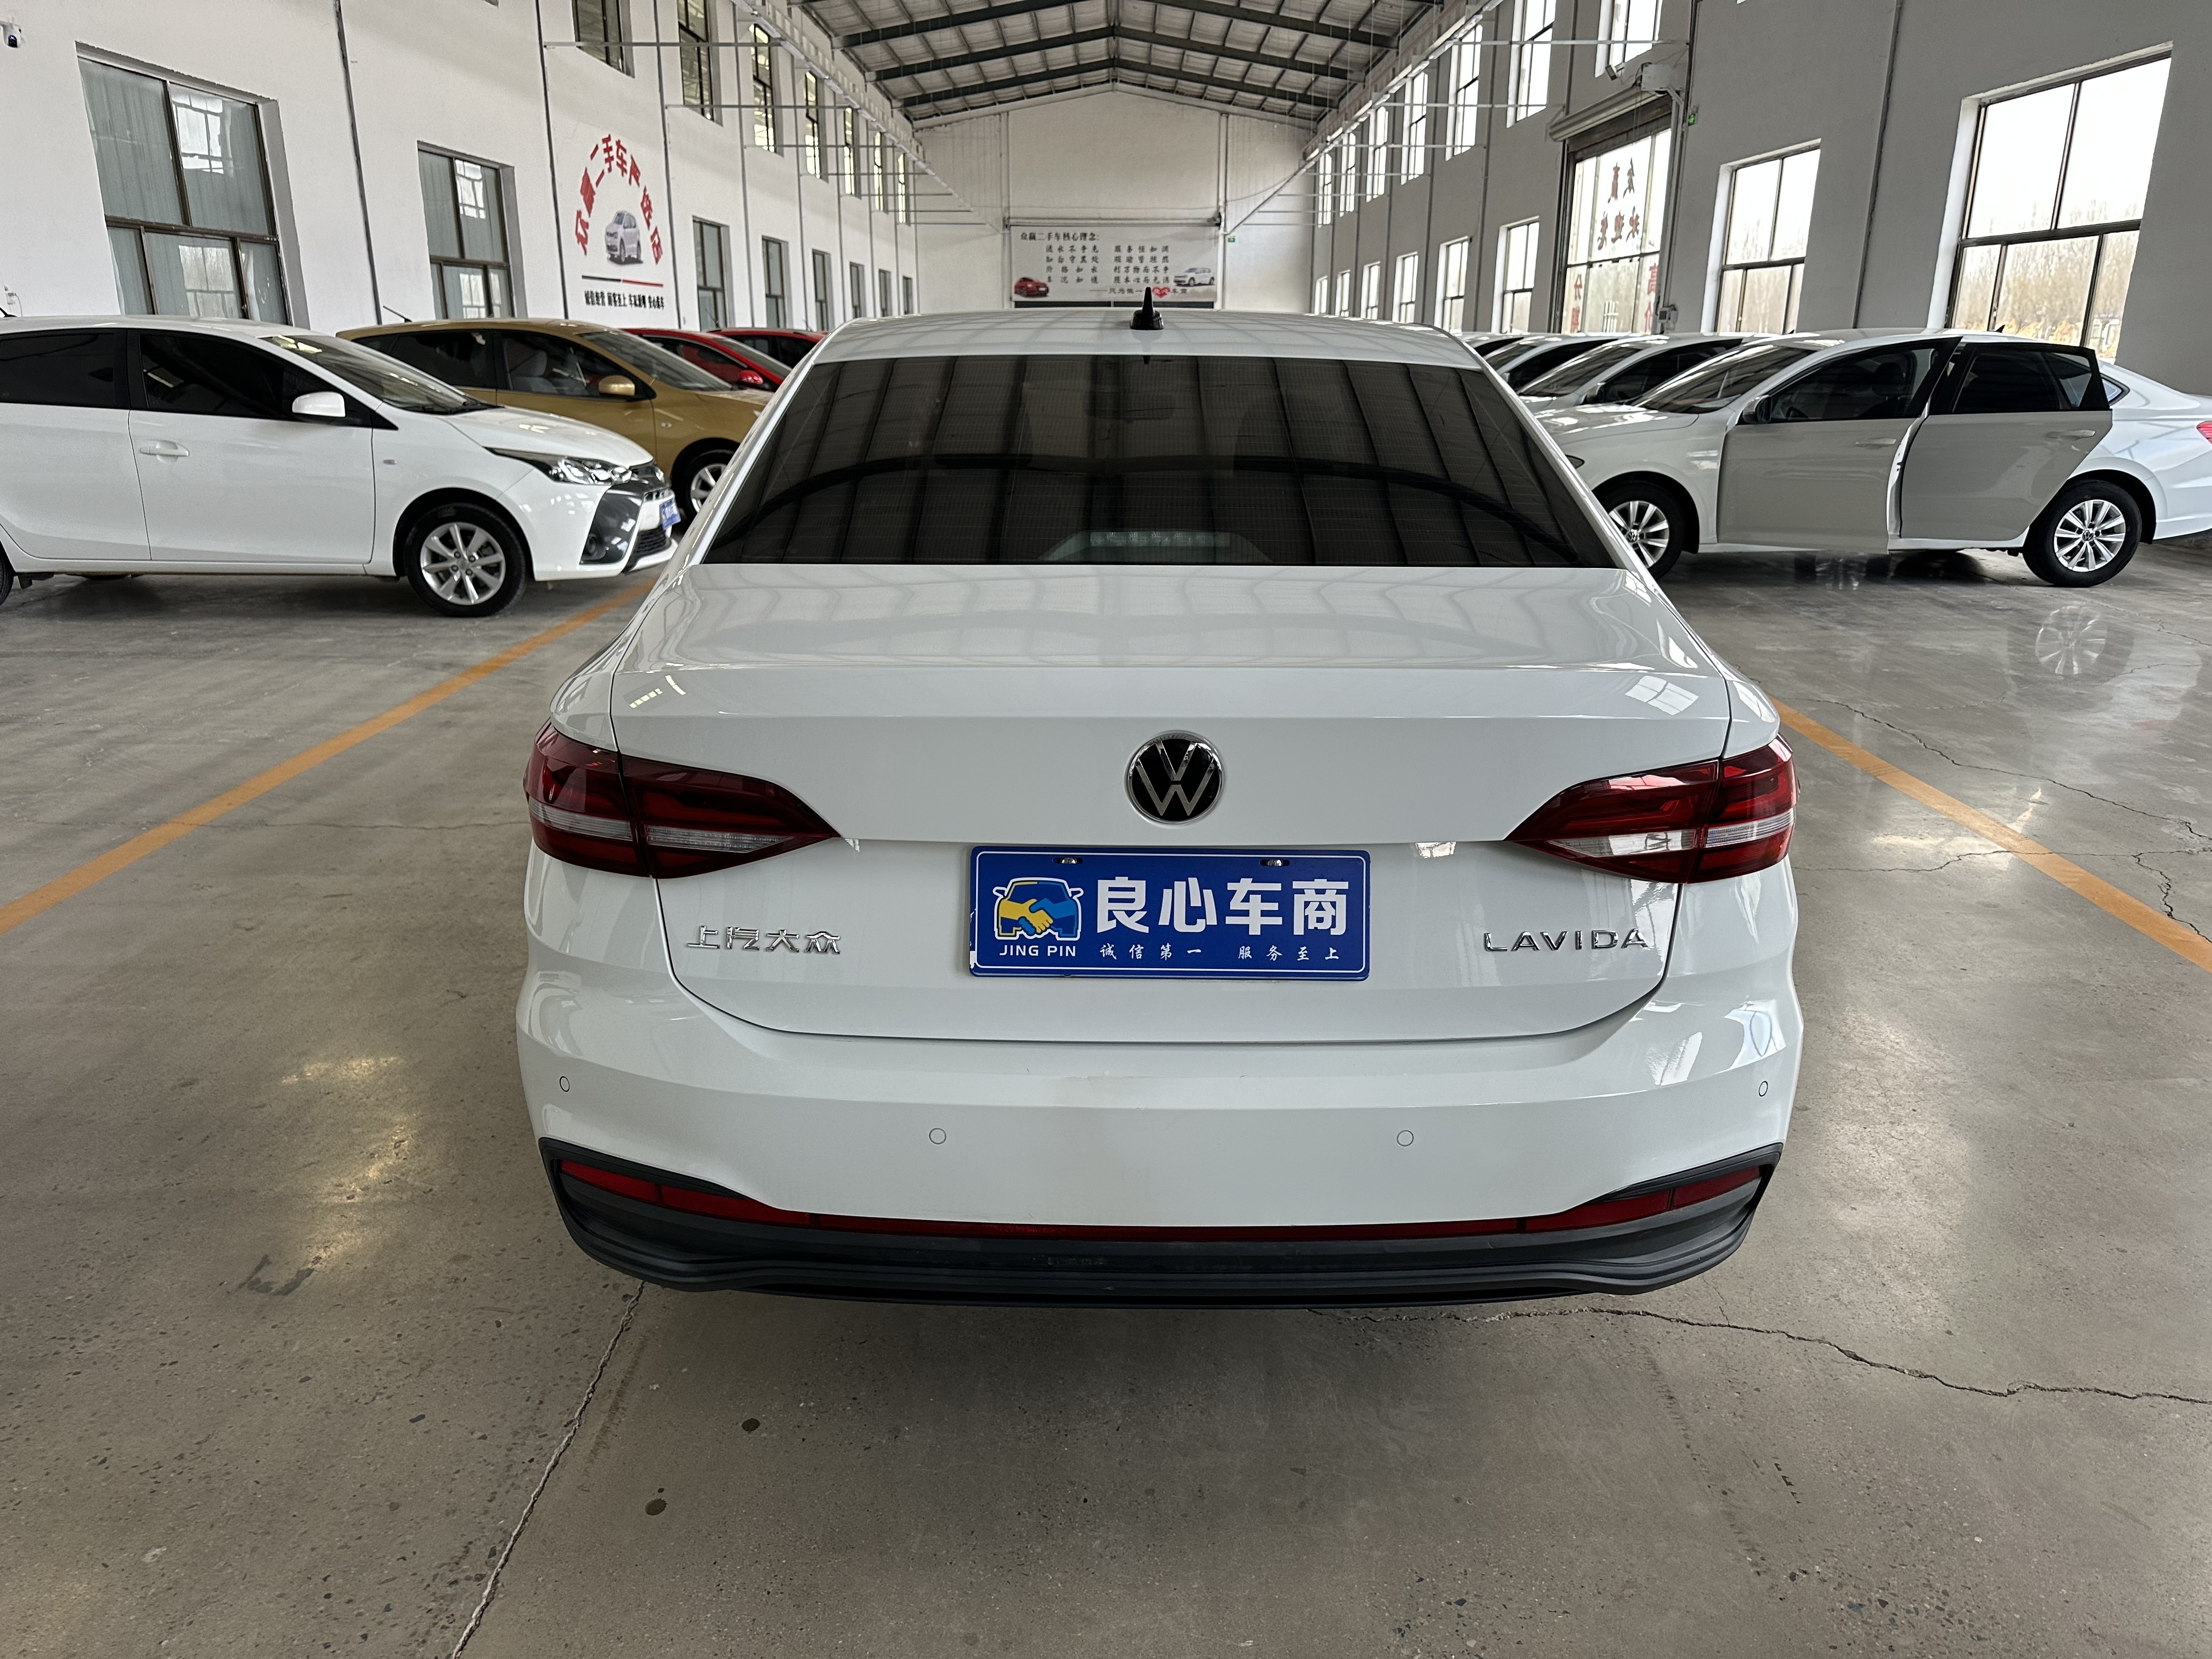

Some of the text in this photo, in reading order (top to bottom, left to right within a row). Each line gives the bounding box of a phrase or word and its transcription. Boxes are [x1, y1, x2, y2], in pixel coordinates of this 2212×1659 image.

[1097, 877, 1348, 935] 良心车商
[687, 925, 840, 955] 上汽大众
[1000, 945, 1075, 956] JING PIN
[1484, 928, 1649, 951] LAVIDA
[1100, 943, 1339, 961] 诚信第一 服务至上
